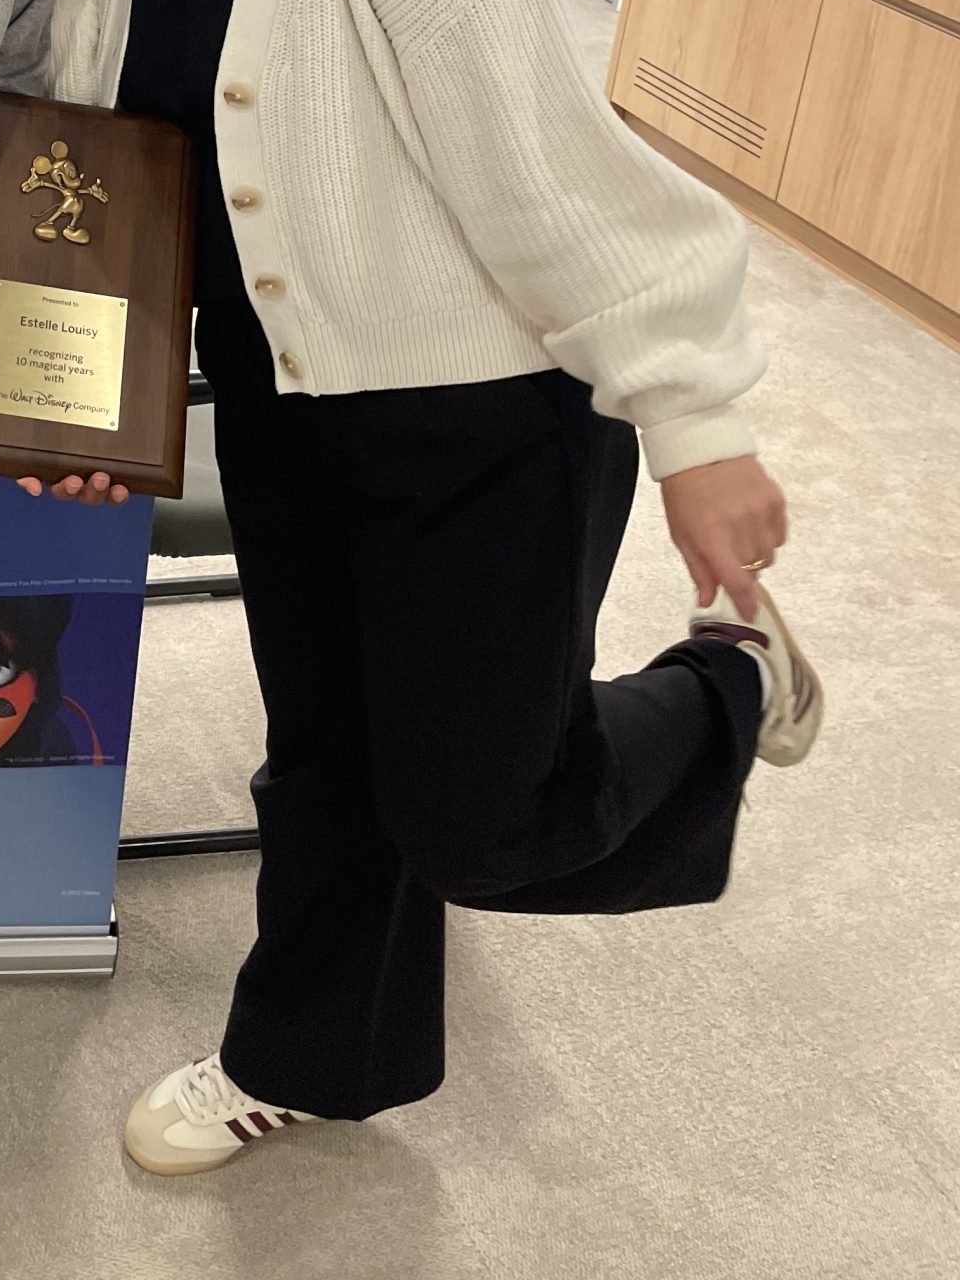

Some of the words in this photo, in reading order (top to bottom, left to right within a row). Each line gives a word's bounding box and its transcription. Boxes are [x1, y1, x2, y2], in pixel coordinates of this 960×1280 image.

[41, 296, 72, 308] Presented
[72, 300, 80, 308] to
[20, 315, 59, 332] Estelle
[61, 322, 99, 339] Louisy
[28, 347, 84, 365] recognizing
[15, 356, 28, 367] 10
[29, 360, 66, 372] magical
[68, 366, 95, 377] years
[43, 373, 65, 384] with
[73, 401, 110, 416] Company
